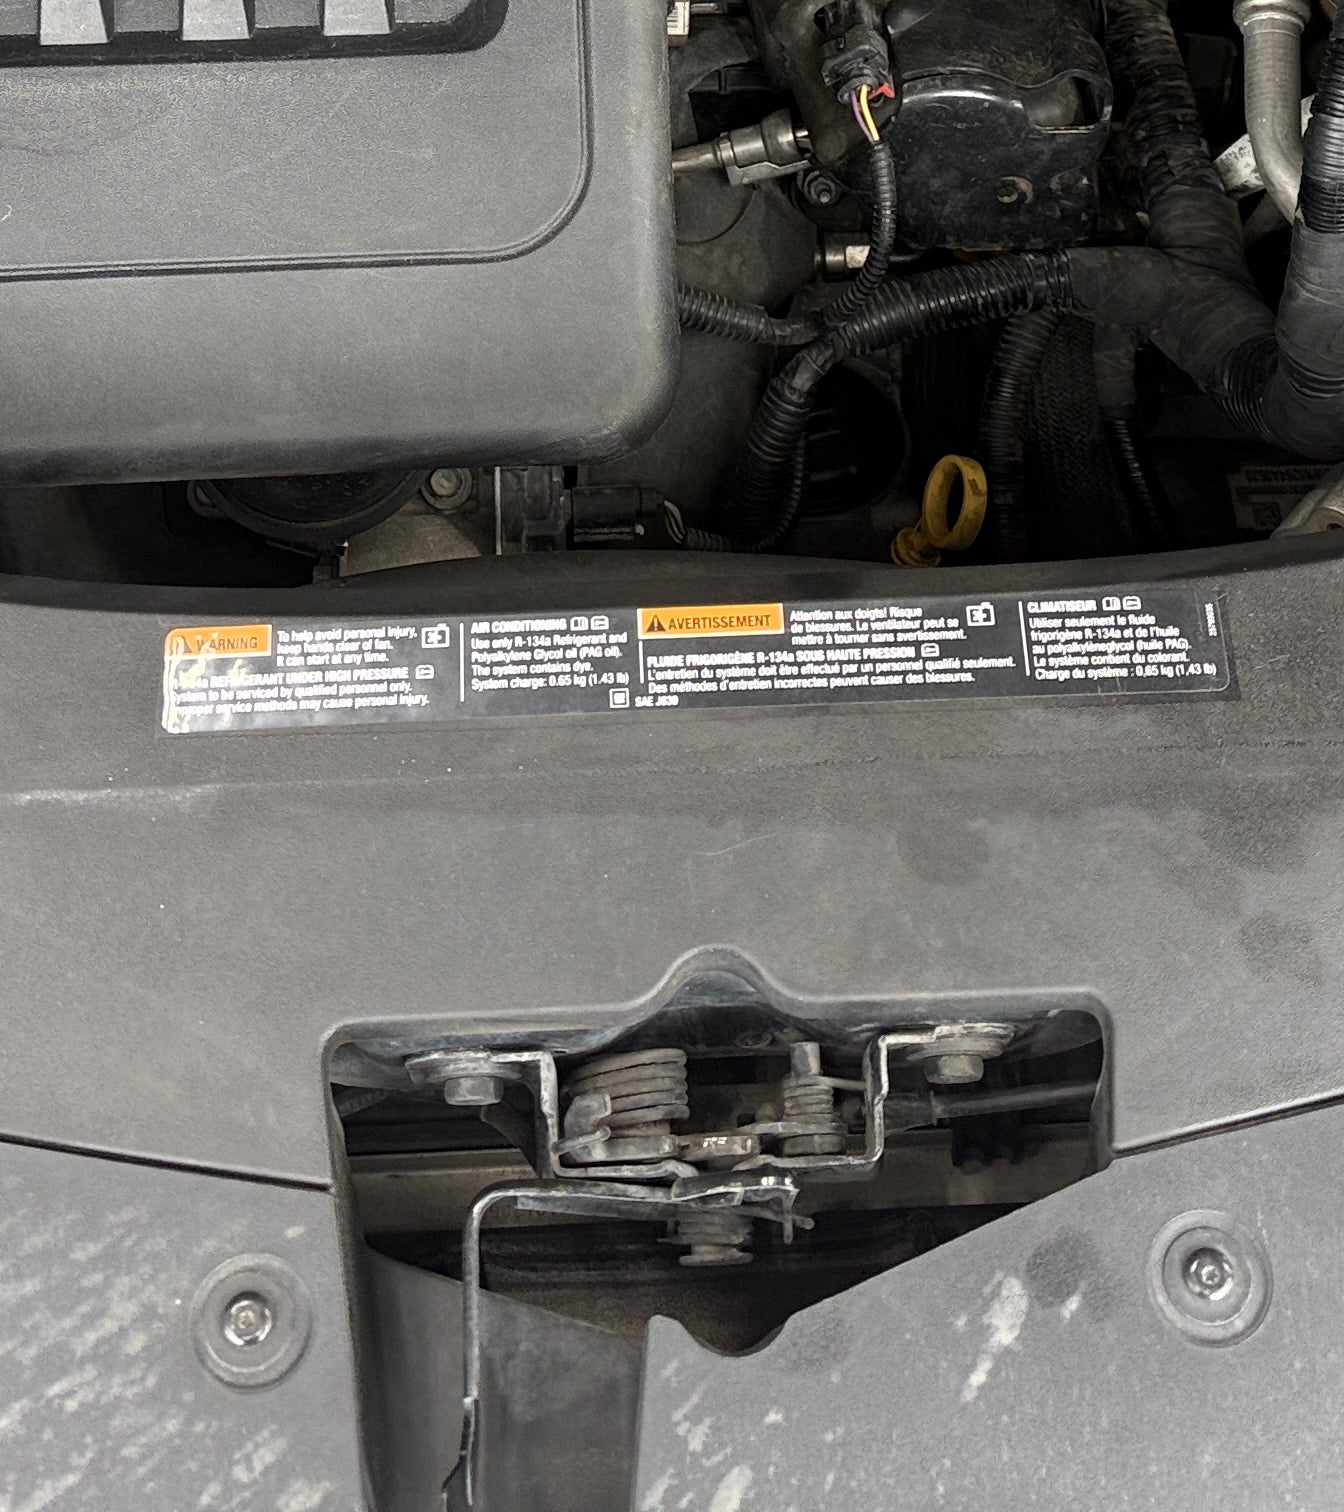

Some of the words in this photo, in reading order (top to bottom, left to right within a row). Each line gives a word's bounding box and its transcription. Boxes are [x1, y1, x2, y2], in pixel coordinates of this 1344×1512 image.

[790, 610, 834, 622] Attention
[835, 610, 853, 620] aux
[855, 607, 888, 620] doigts!
[889, 607, 923, 619] Risque
[1027, 600, 1098, 614] CLIMATISEUR
[471, 622, 491, 634] AIR
[492, 618, 568, 633] CONDITIONING
[668, 614, 772, 631] AVERTISSEMENT
[791, 623, 804, 634] de
[805, 622, 854, 633] blessures.
[856, 620, 869, 631] Le
[870, 619, 921, 631] ventilateur
[923, 617, 946, 630] peut
[947, 618, 959, 628] se
[1029, 617, 1063, 629] Utiliser
[1065, 616, 1116, 628] seulement
[1117, 615, 1127, 626] le
[1128, 614, 1156, 625] fluide
[277, 630, 290, 642] To
[292, 630, 313, 642] help
[315, 629, 342, 640] avoid
[344, 627, 386, 641] personal
[388, 626, 417, 639] injury.
[471, 638, 490, 649] Use
[492, 637, 513, 650] only
[515, 635, 551, 647] R-134a
[553, 633, 607, 647] Refrigerant
[609, 632, 627, 644] and
[792, 634, 824, 645] mettre
[826, 633, 833, 644] à
[834, 633, 869, 644] tourner
[872, 633, 895, 643] sans
[897, 629, 967, 641] avertissement.
[1030, 629, 1083, 643] frigorigène
[1085, 628, 1122, 639] R-134a
[1123, 627, 1134, 638] et
[1135, 626, 1149, 637] de
[1150, 625, 1180, 637] l'huile
[197, 636, 258, 652] WARNING
[277, 643, 301, 655] keep
[304, 642, 334, 653] hands
[336, 641, 360, 652] clear
[362, 640, 372, 651] of
[374, 639, 393, 650] fan.
[1032, 644, 1045, 654] au
[1136, 639, 1163, 652] (huile
[286, 656, 304, 666] can
[306, 654, 329, 665] start
[331, 654, 342, 664] at
[344, 653, 362, 665] any
[364, 652, 389, 663] time.
[471, 650, 532, 664] Polyalkylene
[534, 648, 563, 661] Glycol
[565, 648, 577, 659] oil
[579, 646, 603, 660] (PAG
[604, 646, 623, 658] oil).
[647, 655, 684, 668] FLUIDE
[686, 651, 755, 666] FRIGORIGÈNE
[757, 651, 794, 663] R-134a
[796, 650, 825, 662] SOUS
[826, 648, 862, 661] HAUTE
[863, 646, 916, 659] PRESSION
[1034, 656, 1046, 667] Le
[1048, 654, 1089, 668] système
[1091, 653, 1130, 664] contient
[1132, 653, 1145, 663] du
[1147, 651, 1190, 663] colorant.
[286, 671, 323, 685] UNDER
[325, 669, 351, 682] HIGH
[353, 667, 409, 681] PRESSURE
[472, 664, 490, 676] The
[492, 664, 528, 677] system
[530, 661, 571, 674] contains
[573, 661, 594, 673] dye.
[648, 668, 698, 680] L'entretien
[701, 667, 714, 678] du
[716, 665, 756, 679] système
[758, 665, 777, 676] doit
[779, 663, 798, 675] être
[801, 662, 840, 675] effectué
[842, 664, 859, 675] par
[861, 663, 873, 673] un
[876, 659, 923, 674] personnel
[925, 657, 961, 672] qualifié
[963, 656, 1016, 669] seulement.
[1035, 668, 1070, 681] Charge
[1072, 668, 1085, 678] du
[1087, 666, 1128, 680] système
[1136, 665, 1159, 677] 0,65
[1161, 665, 1174, 678] kg
[1176, 663, 1202, 676] (1,43
[1204, 663, 1217, 676] lb)
[471, 678, 508, 691] System
[510, 677, 547, 690] charge:
[548, 675, 572, 687] 0.65
[573, 674, 587, 687] kg
[588, 672, 614, 686] (1.43
[616, 672, 630, 685] lb)
[648, 682, 668, 694] Des
[670, 679, 718, 692] méthodes
[720, 678, 772, 691] d'entretien
[774, 676, 828, 689] incorrectes
[830, 675, 869, 689] peuvent
[871, 675, 904, 685] causer
[906, 672, 924, 684] des
[925, 672, 975, 684] blessures.
[173, 691, 207, 705] ystem
[208, 690, 219, 701] to
[221, 689, 234, 701] be
[236, 687, 278, 700] serviced
[280, 687, 293, 700] by
[295, 684, 337, 698] qualified
[339, 682, 387, 696] personnel
[389, 681, 412, 694] only.
[635, 696, 654, 707] SAE
[216, 702, 252, 714] service
[254, 699, 297, 712] methods
[300, 699, 321, 711] may
[323, 697, 353, 709] cause
[355, 695, 397, 709] personal
[399, 693, 429, 706] injury.
